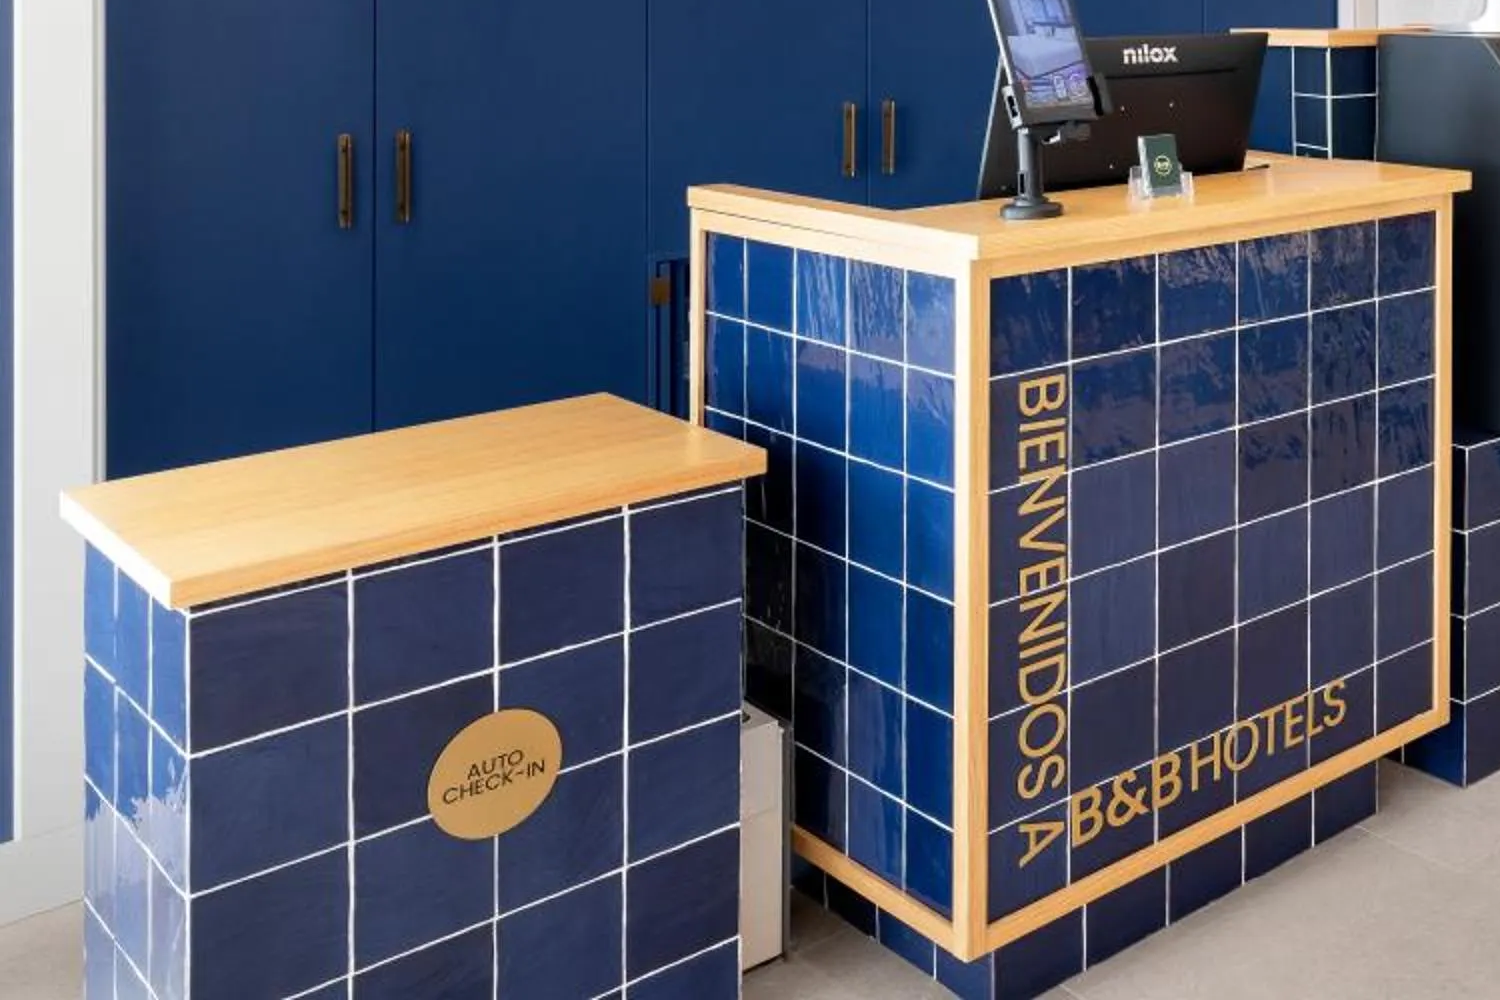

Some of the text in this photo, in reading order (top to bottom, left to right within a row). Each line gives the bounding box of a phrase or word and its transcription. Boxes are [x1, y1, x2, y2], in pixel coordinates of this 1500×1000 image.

[1122, 43, 1178, 65] nilox
[1017, 372, 1068, 868] BIENVENIDOS A
[442, 759, 546, 805] CHECK-IN
[467, 749, 524, 780] AUTO
[1070, 679, 1348, 850] B&B HOTELS
